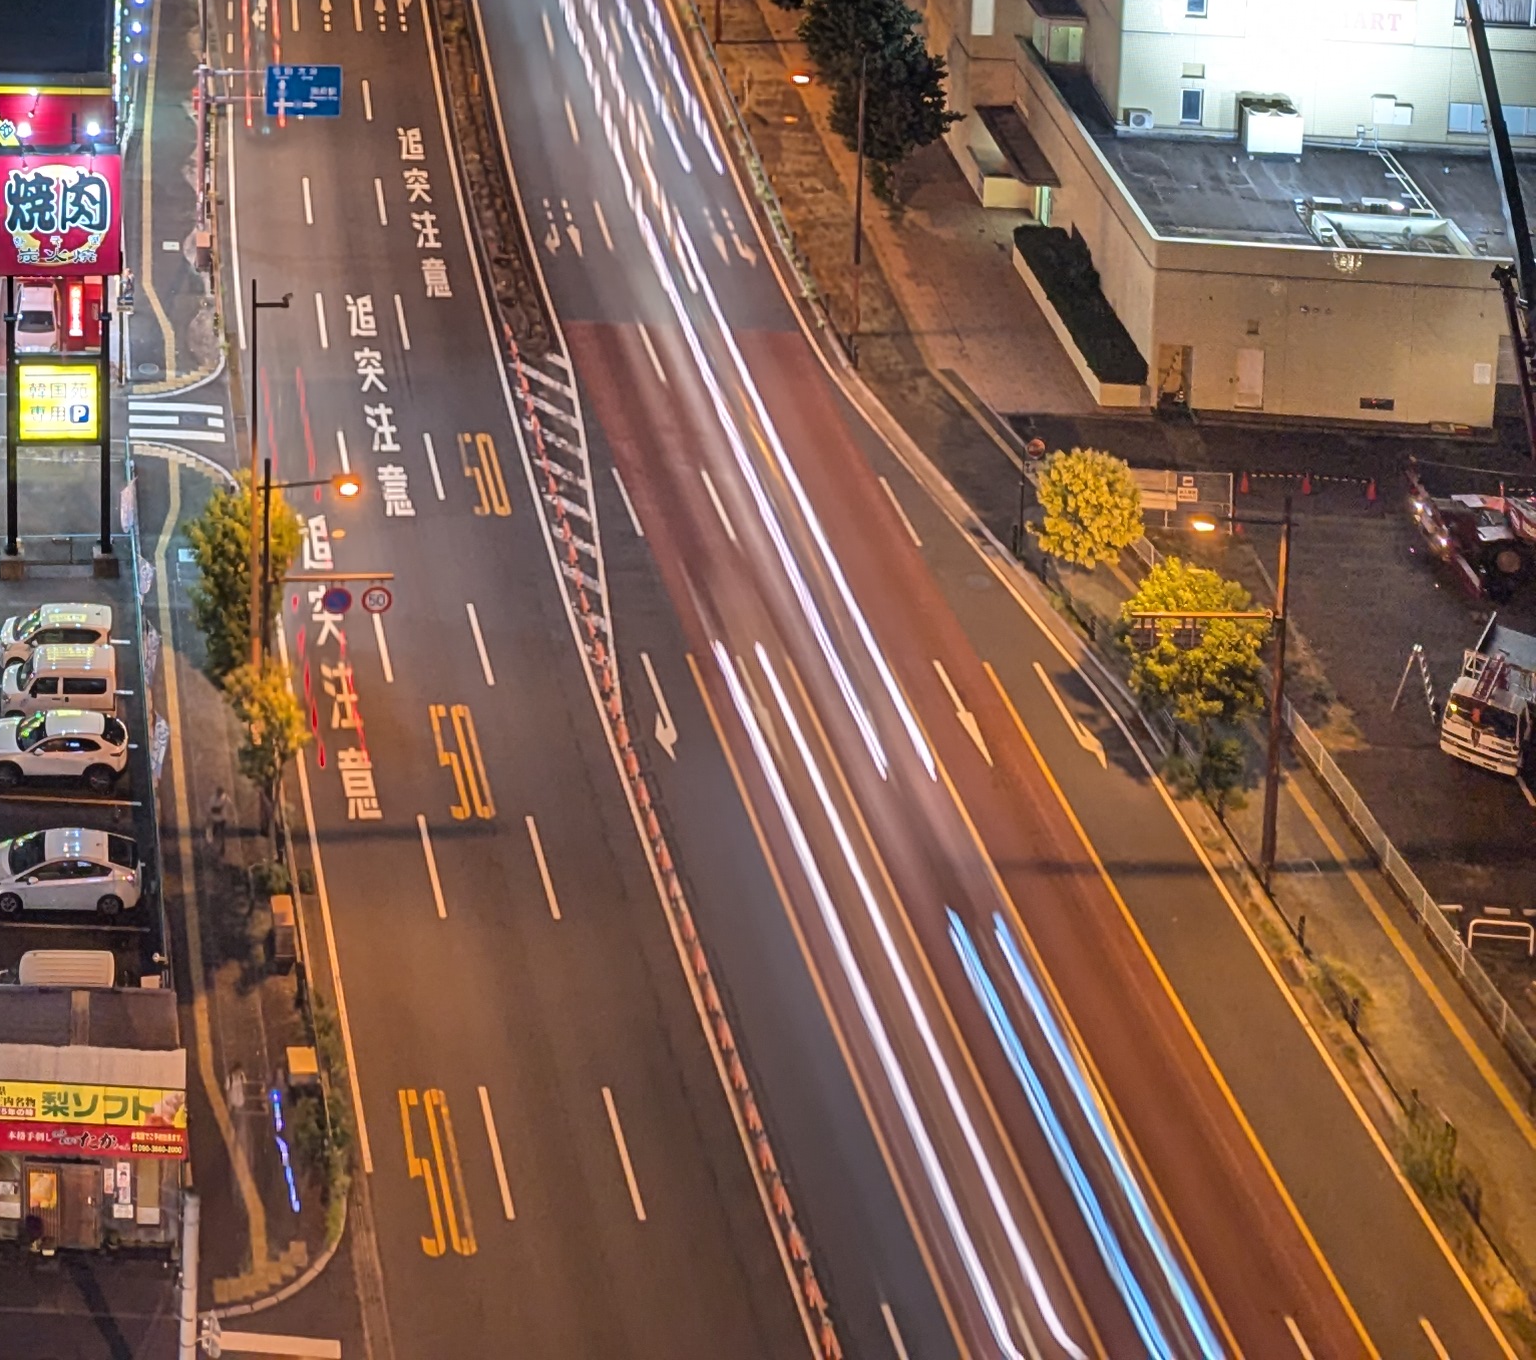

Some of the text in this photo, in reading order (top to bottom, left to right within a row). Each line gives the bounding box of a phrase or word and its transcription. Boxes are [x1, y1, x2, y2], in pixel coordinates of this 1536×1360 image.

[4, 170, 112, 233] 焼肉
[396, 127, 454, 299] 追突注意
[17, 247, 98, 264] 炭火焼
[28, 381, 89, 400] 韓国苑
[29, 404, 66, 423] 専用
[345, 293, 416, 518] 追突注意
[457, 431, 513, 517] 50
[368, 593, 386, 608] 50
[427, 702, 497, 821] 50
[41, 1090, 156, 1122] 梨ソフト
[397, 1088, 479, 1258] 50
